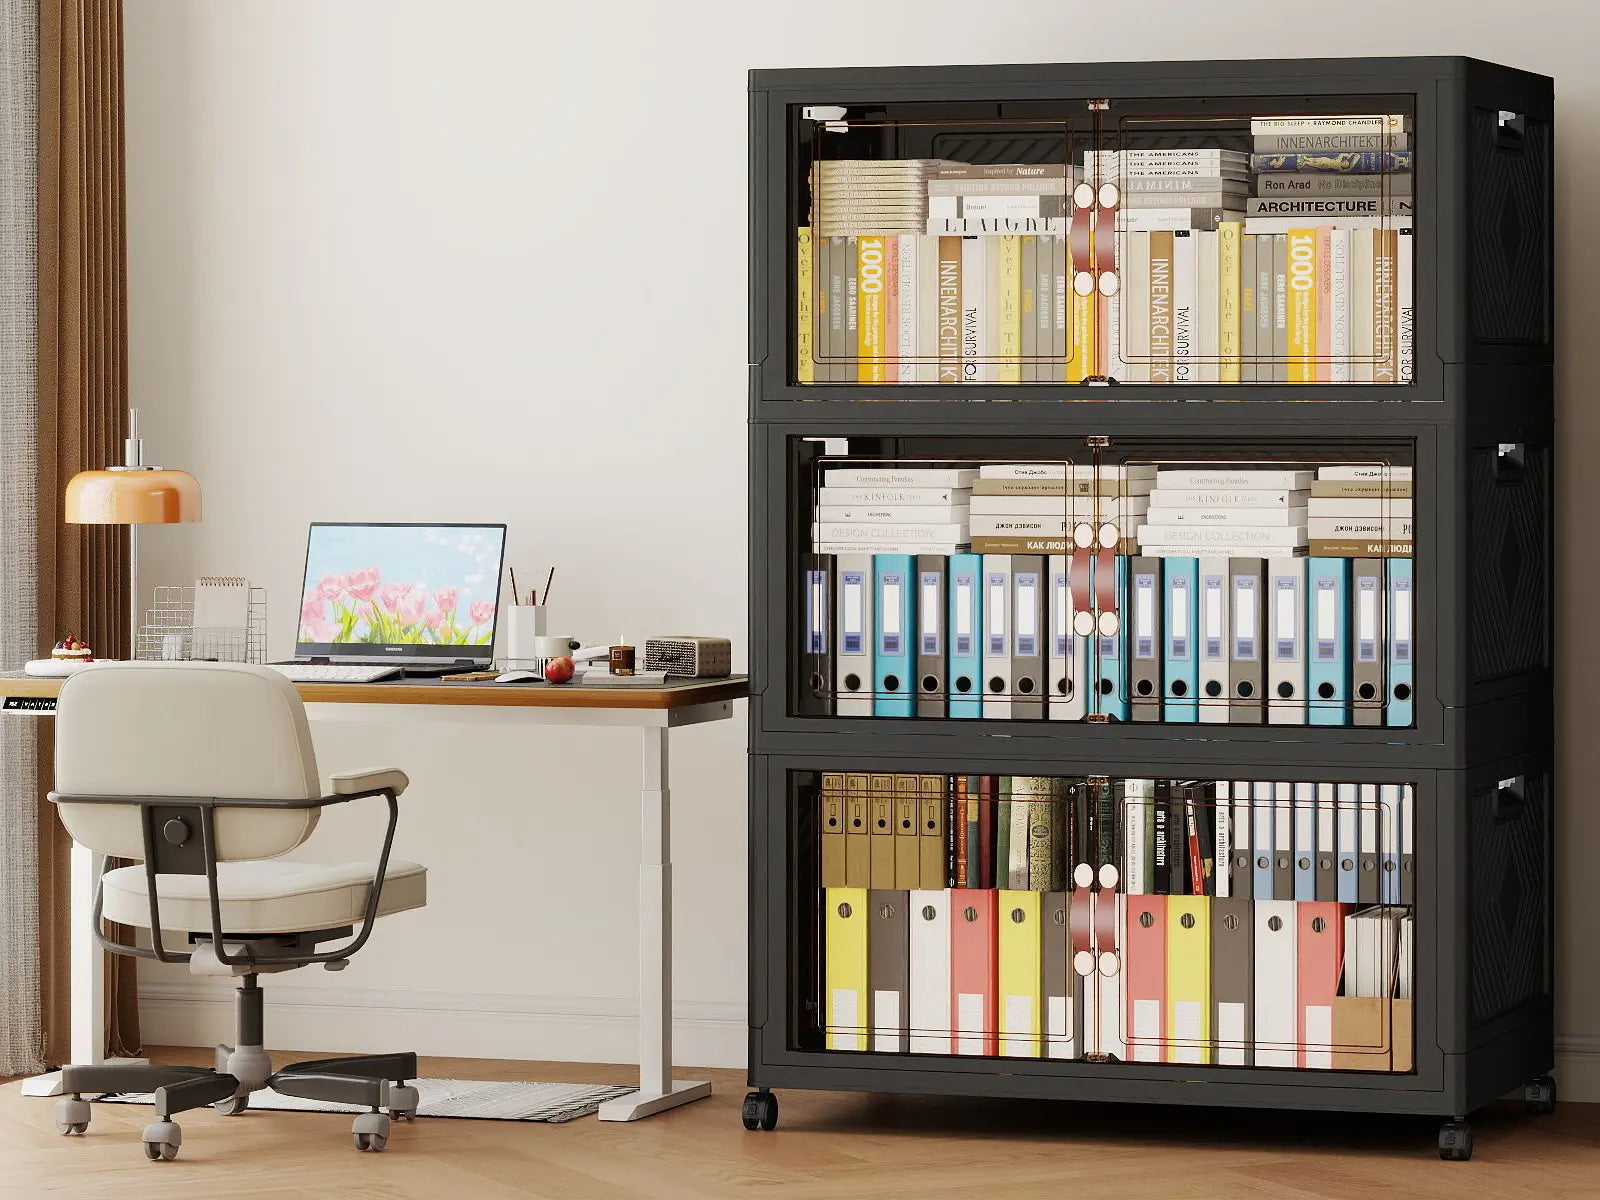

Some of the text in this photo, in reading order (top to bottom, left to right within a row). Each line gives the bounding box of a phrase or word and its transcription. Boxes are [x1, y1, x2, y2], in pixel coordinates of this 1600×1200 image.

[1015, 167, 1045, 176] Nature
[1265, 180, 1285, 190] Ron
[1288, 180, 1311, 190] Arad
[1257, 200, 1377, 213] ARCHITECTURE
[861, 239, 883, 294] 1000
[1291, 235, 1314, 291] 1000
[964, 307, 977, 356] SURVIVAL
[1176, 306, 1189, 356] SURVIVAL
[831, 528, 935, 539] DESIGN COLLECTION
[1164, 530, 1271, 541] DESIGN COLLECTION
[1026, 541, 1045, 550] КАК
